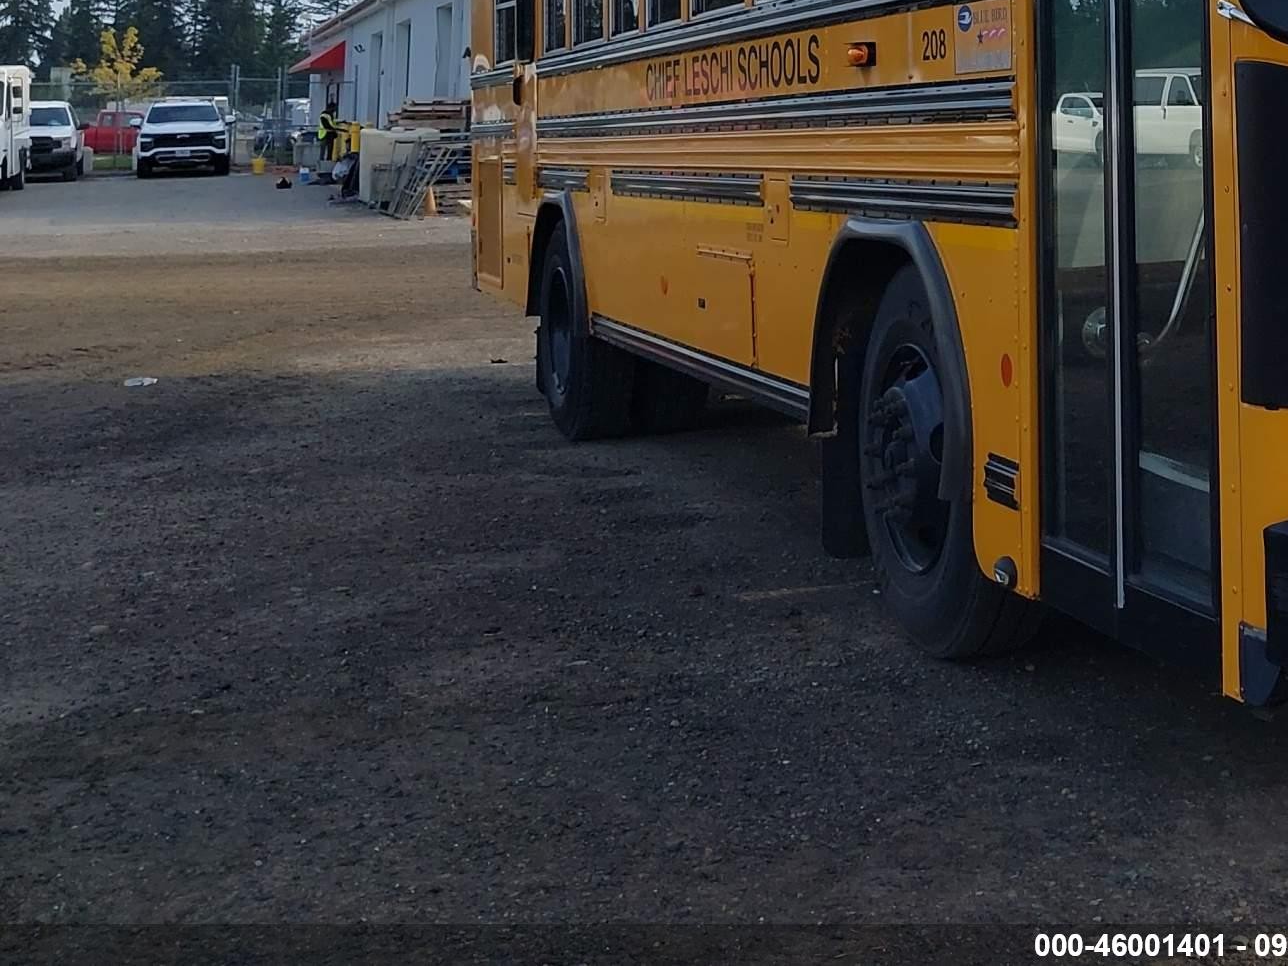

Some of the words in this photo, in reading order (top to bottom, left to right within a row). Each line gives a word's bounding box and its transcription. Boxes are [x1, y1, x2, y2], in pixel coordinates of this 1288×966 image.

[646, 61, 680, 103] CHIEF
[684, 49, 733, 96] LESCHI
[737, 34, 820, 90] SCHOOLS
[922, 29, 947, 62] 208
